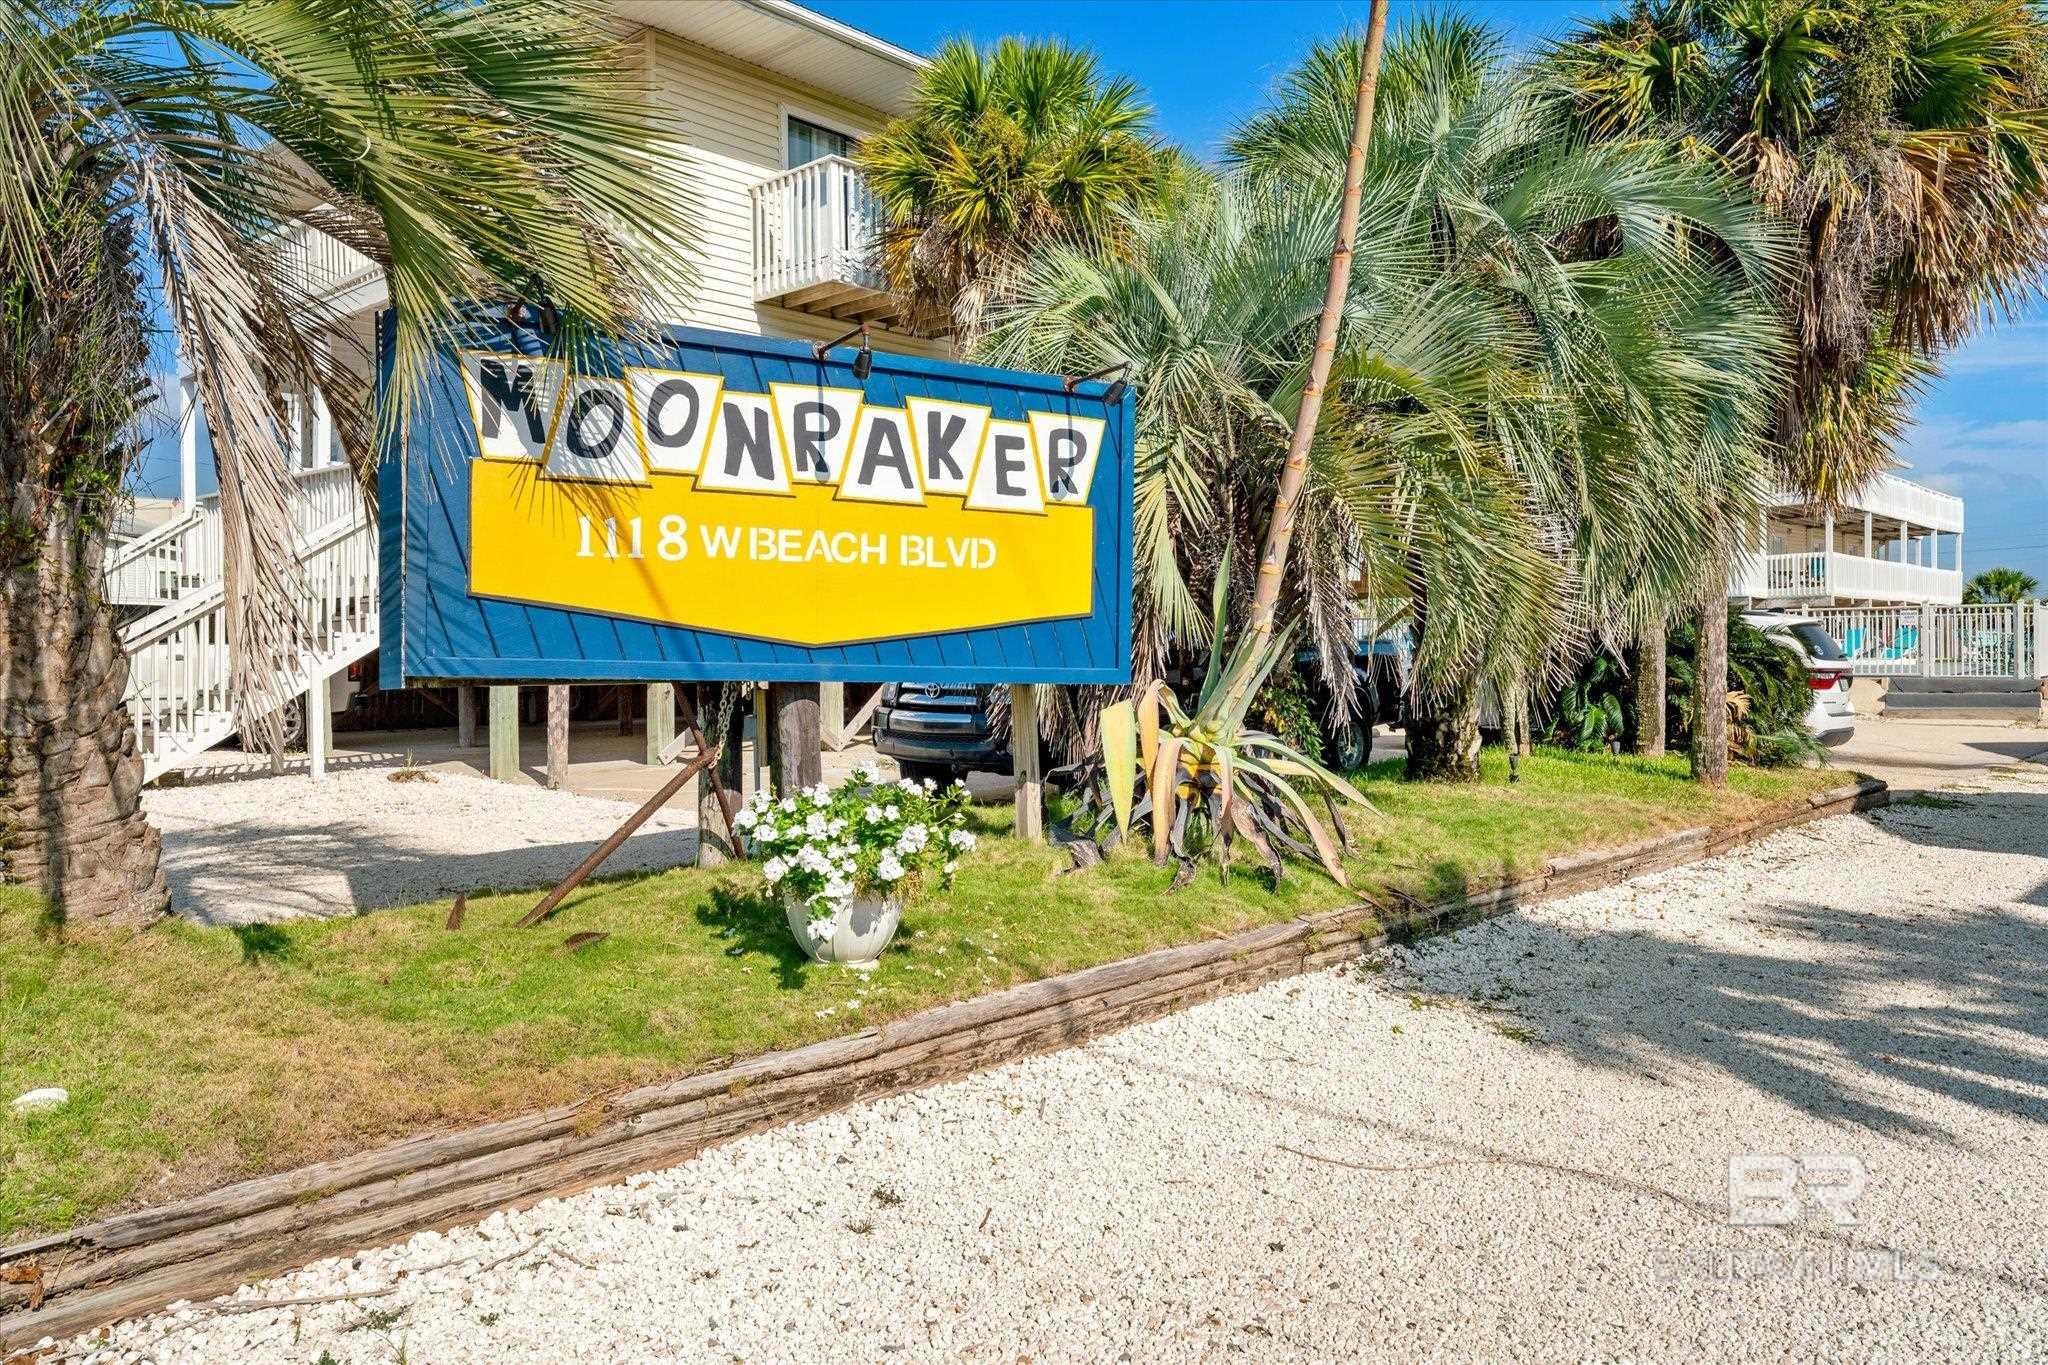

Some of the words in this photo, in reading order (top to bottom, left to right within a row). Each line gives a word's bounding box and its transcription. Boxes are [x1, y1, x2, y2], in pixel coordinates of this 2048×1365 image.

[480, 358, 1087, 496] MOONRAKER
[576, 514, 688, 561] 1118
[699, 525, 744, 558] W
[749, 527, 887, 565] BEACH
[900, 535, 997, 568] BLVD
